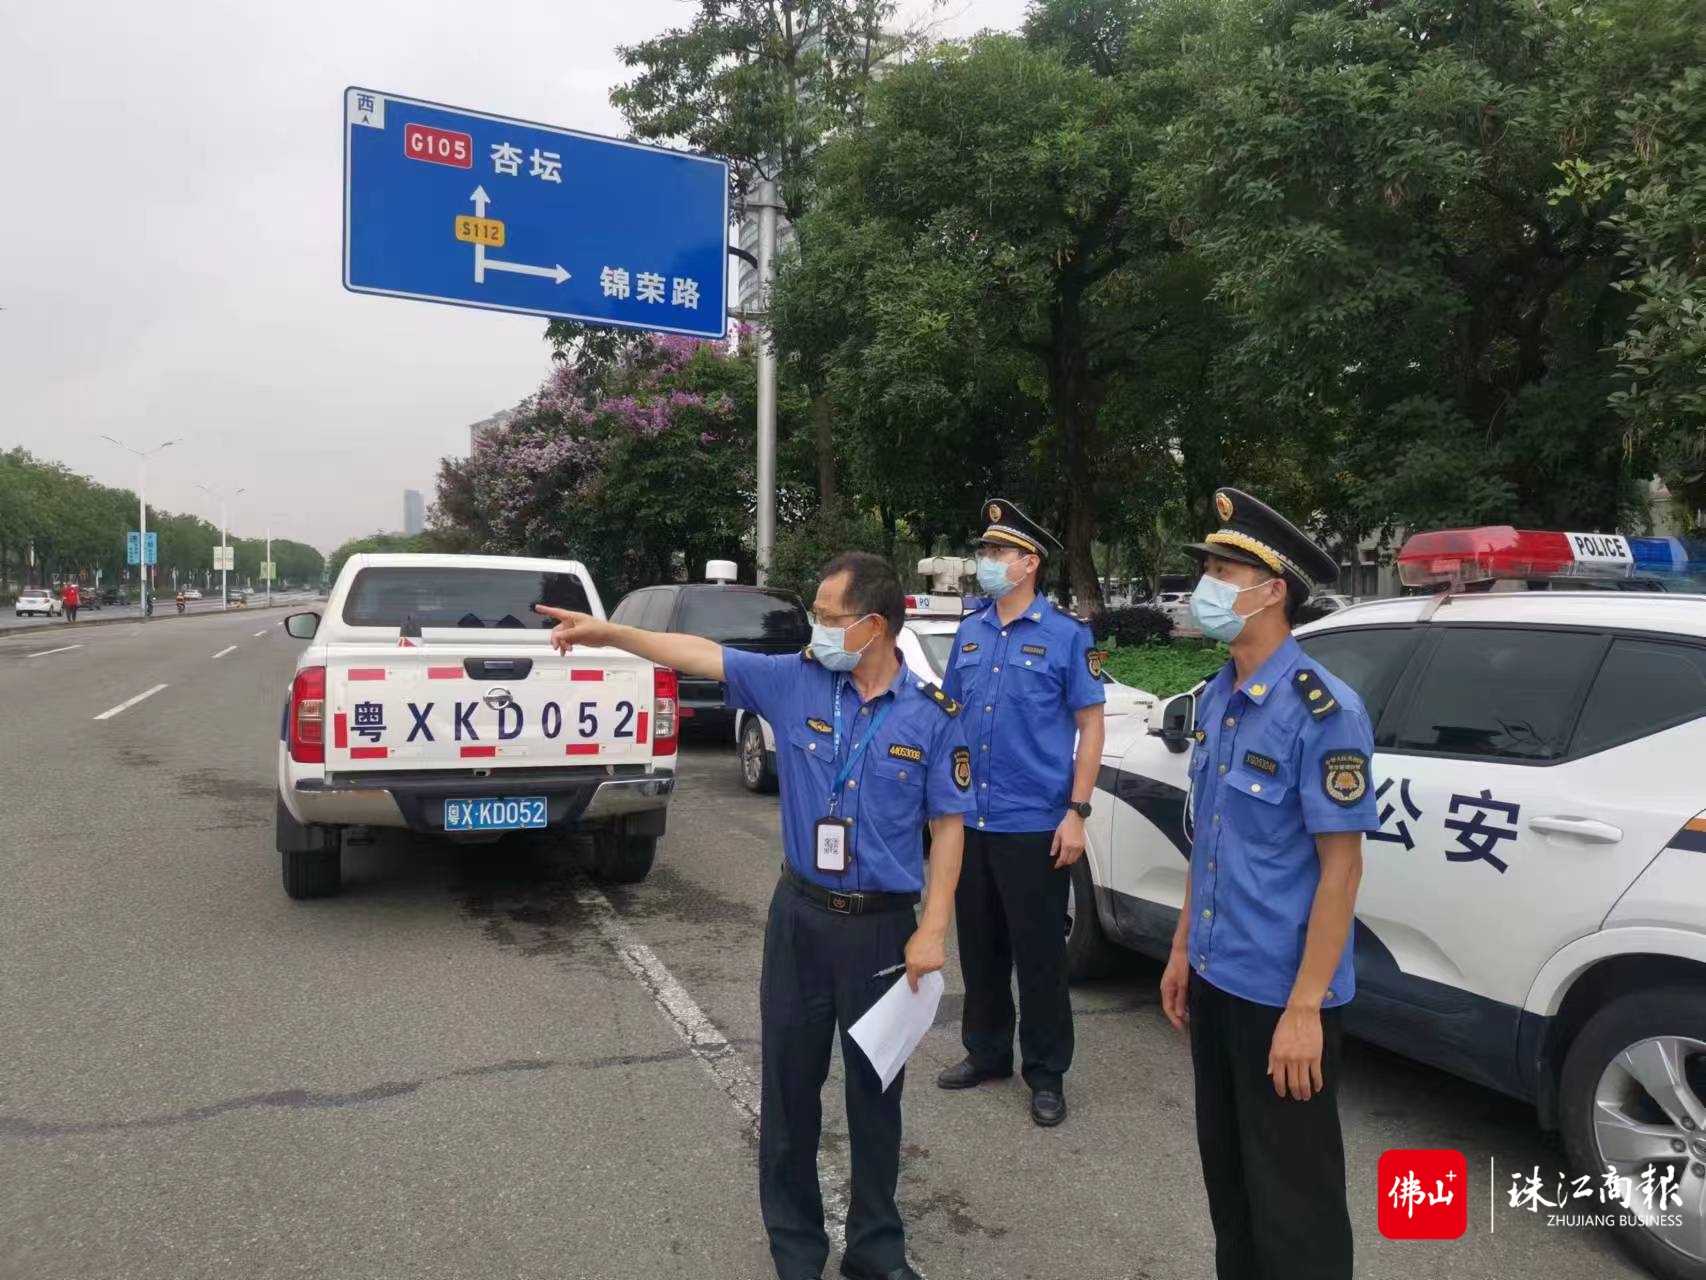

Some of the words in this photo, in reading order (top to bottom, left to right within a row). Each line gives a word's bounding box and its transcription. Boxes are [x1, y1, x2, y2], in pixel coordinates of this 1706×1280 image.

[356, 93, 376, 113] 西
[411, 132, 467, 160] G105
[490, 141, 564, 185] 杏坛
[462, 221, 501, 241] S112
[599, 265, 702, 310] 锦荣路
[1574, 535, 1626, 558] POLICE
[1366, 777, 1521, 875] 公安
